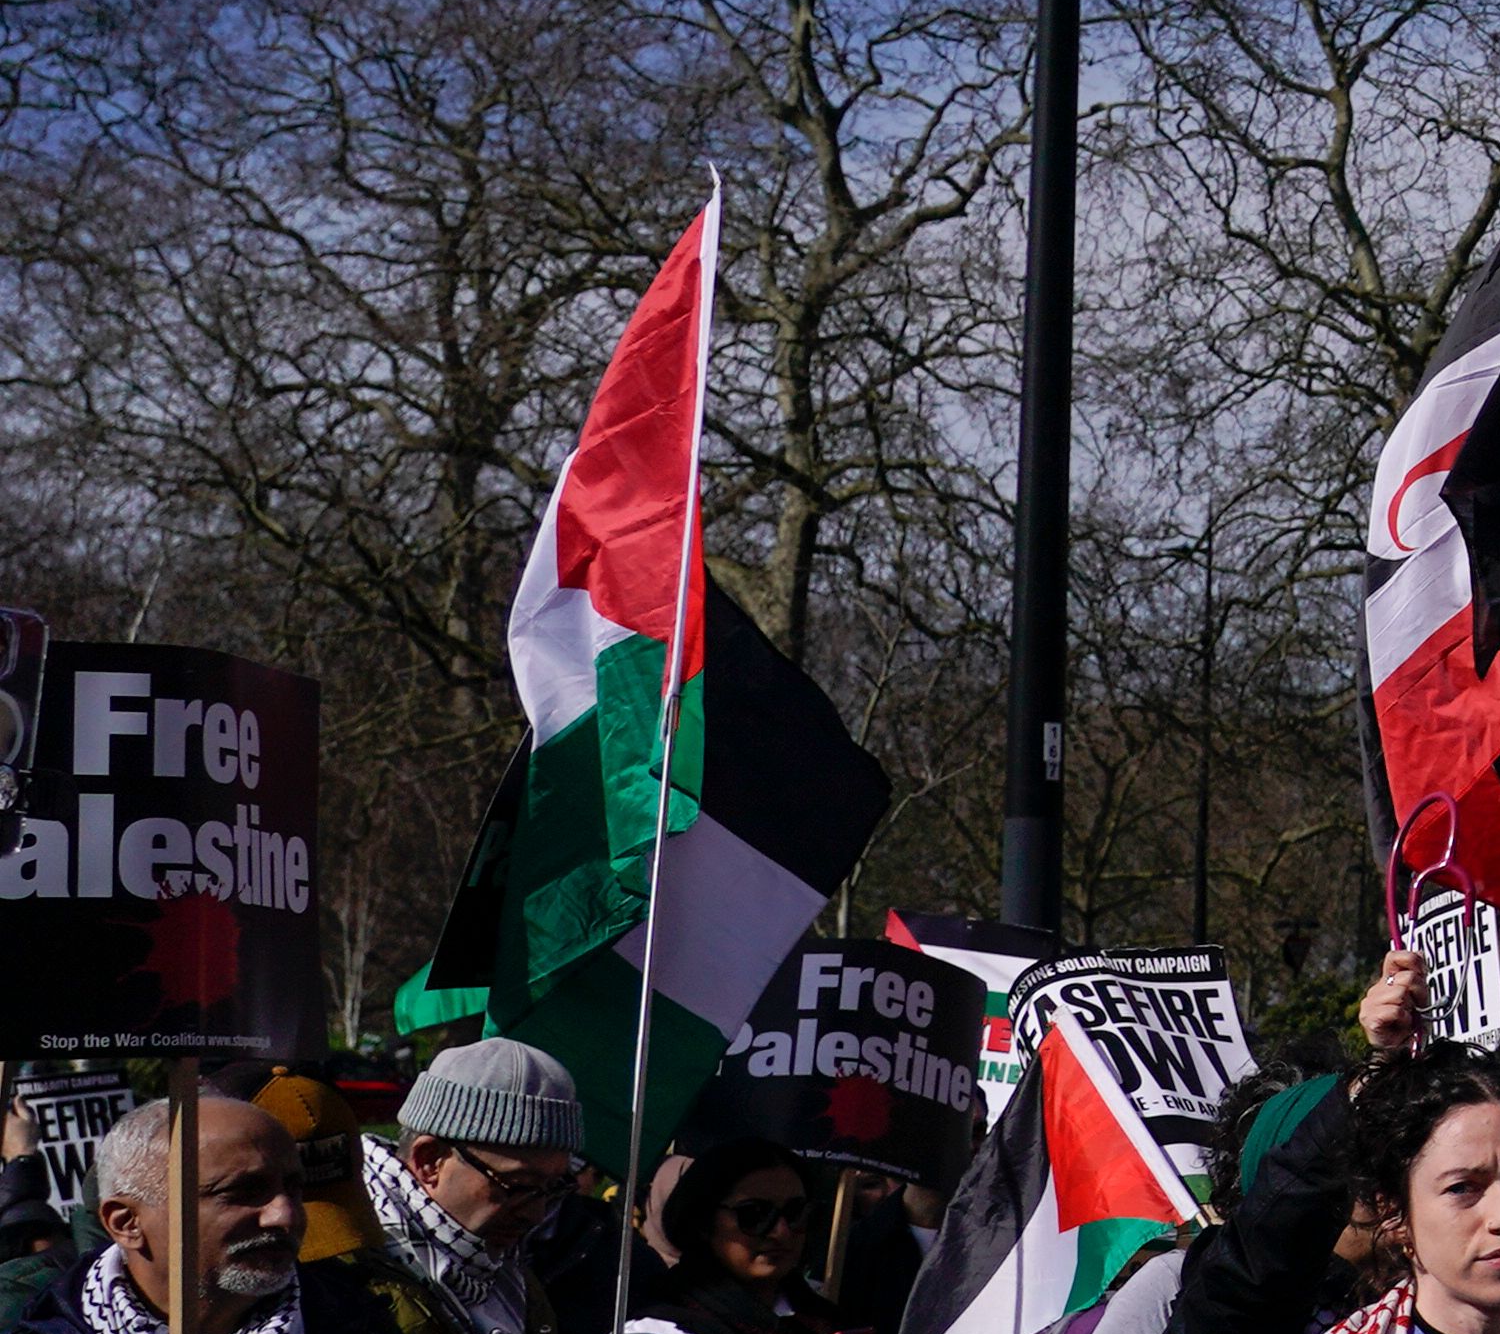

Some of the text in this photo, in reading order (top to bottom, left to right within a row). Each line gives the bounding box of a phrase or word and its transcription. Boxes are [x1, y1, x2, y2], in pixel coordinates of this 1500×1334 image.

[73, 671, 260, 789] Free
[1055, 954, 1211, 976] SOLIDARITY CAMPAIGN
[797, 953, 935, 1028] Free
[40, 1033, 79, 1050] Stop
[83, 1033, 110, 1048] the
[114, 1033, 146, 1048] War
[150, 1031, 204, 1048] Coalition
[1166, 1094, 1195, 1114] END
